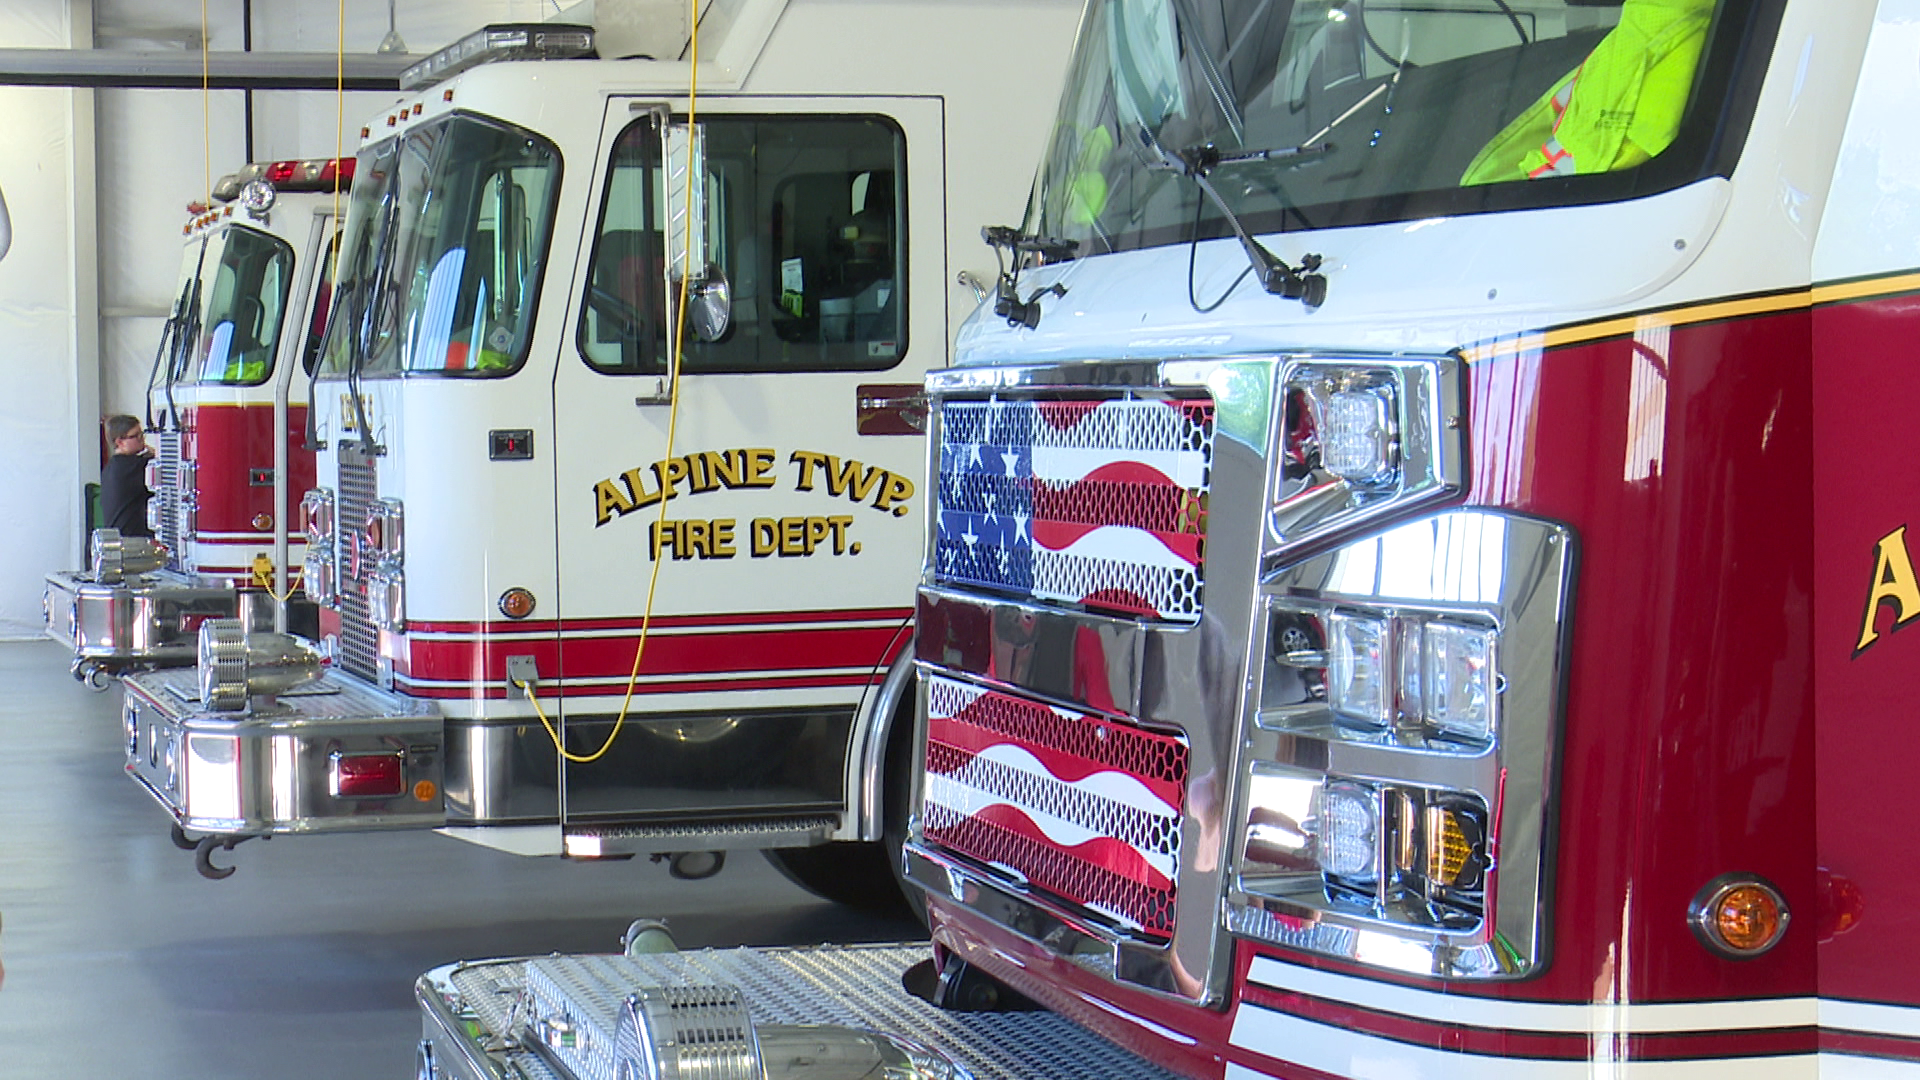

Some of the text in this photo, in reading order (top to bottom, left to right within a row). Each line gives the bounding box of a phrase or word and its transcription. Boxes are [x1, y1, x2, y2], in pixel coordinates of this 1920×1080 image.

[592, 448, 915, 529] ALPINE TWP.
[649, 515, 862, 562] FIRE DEPT.
